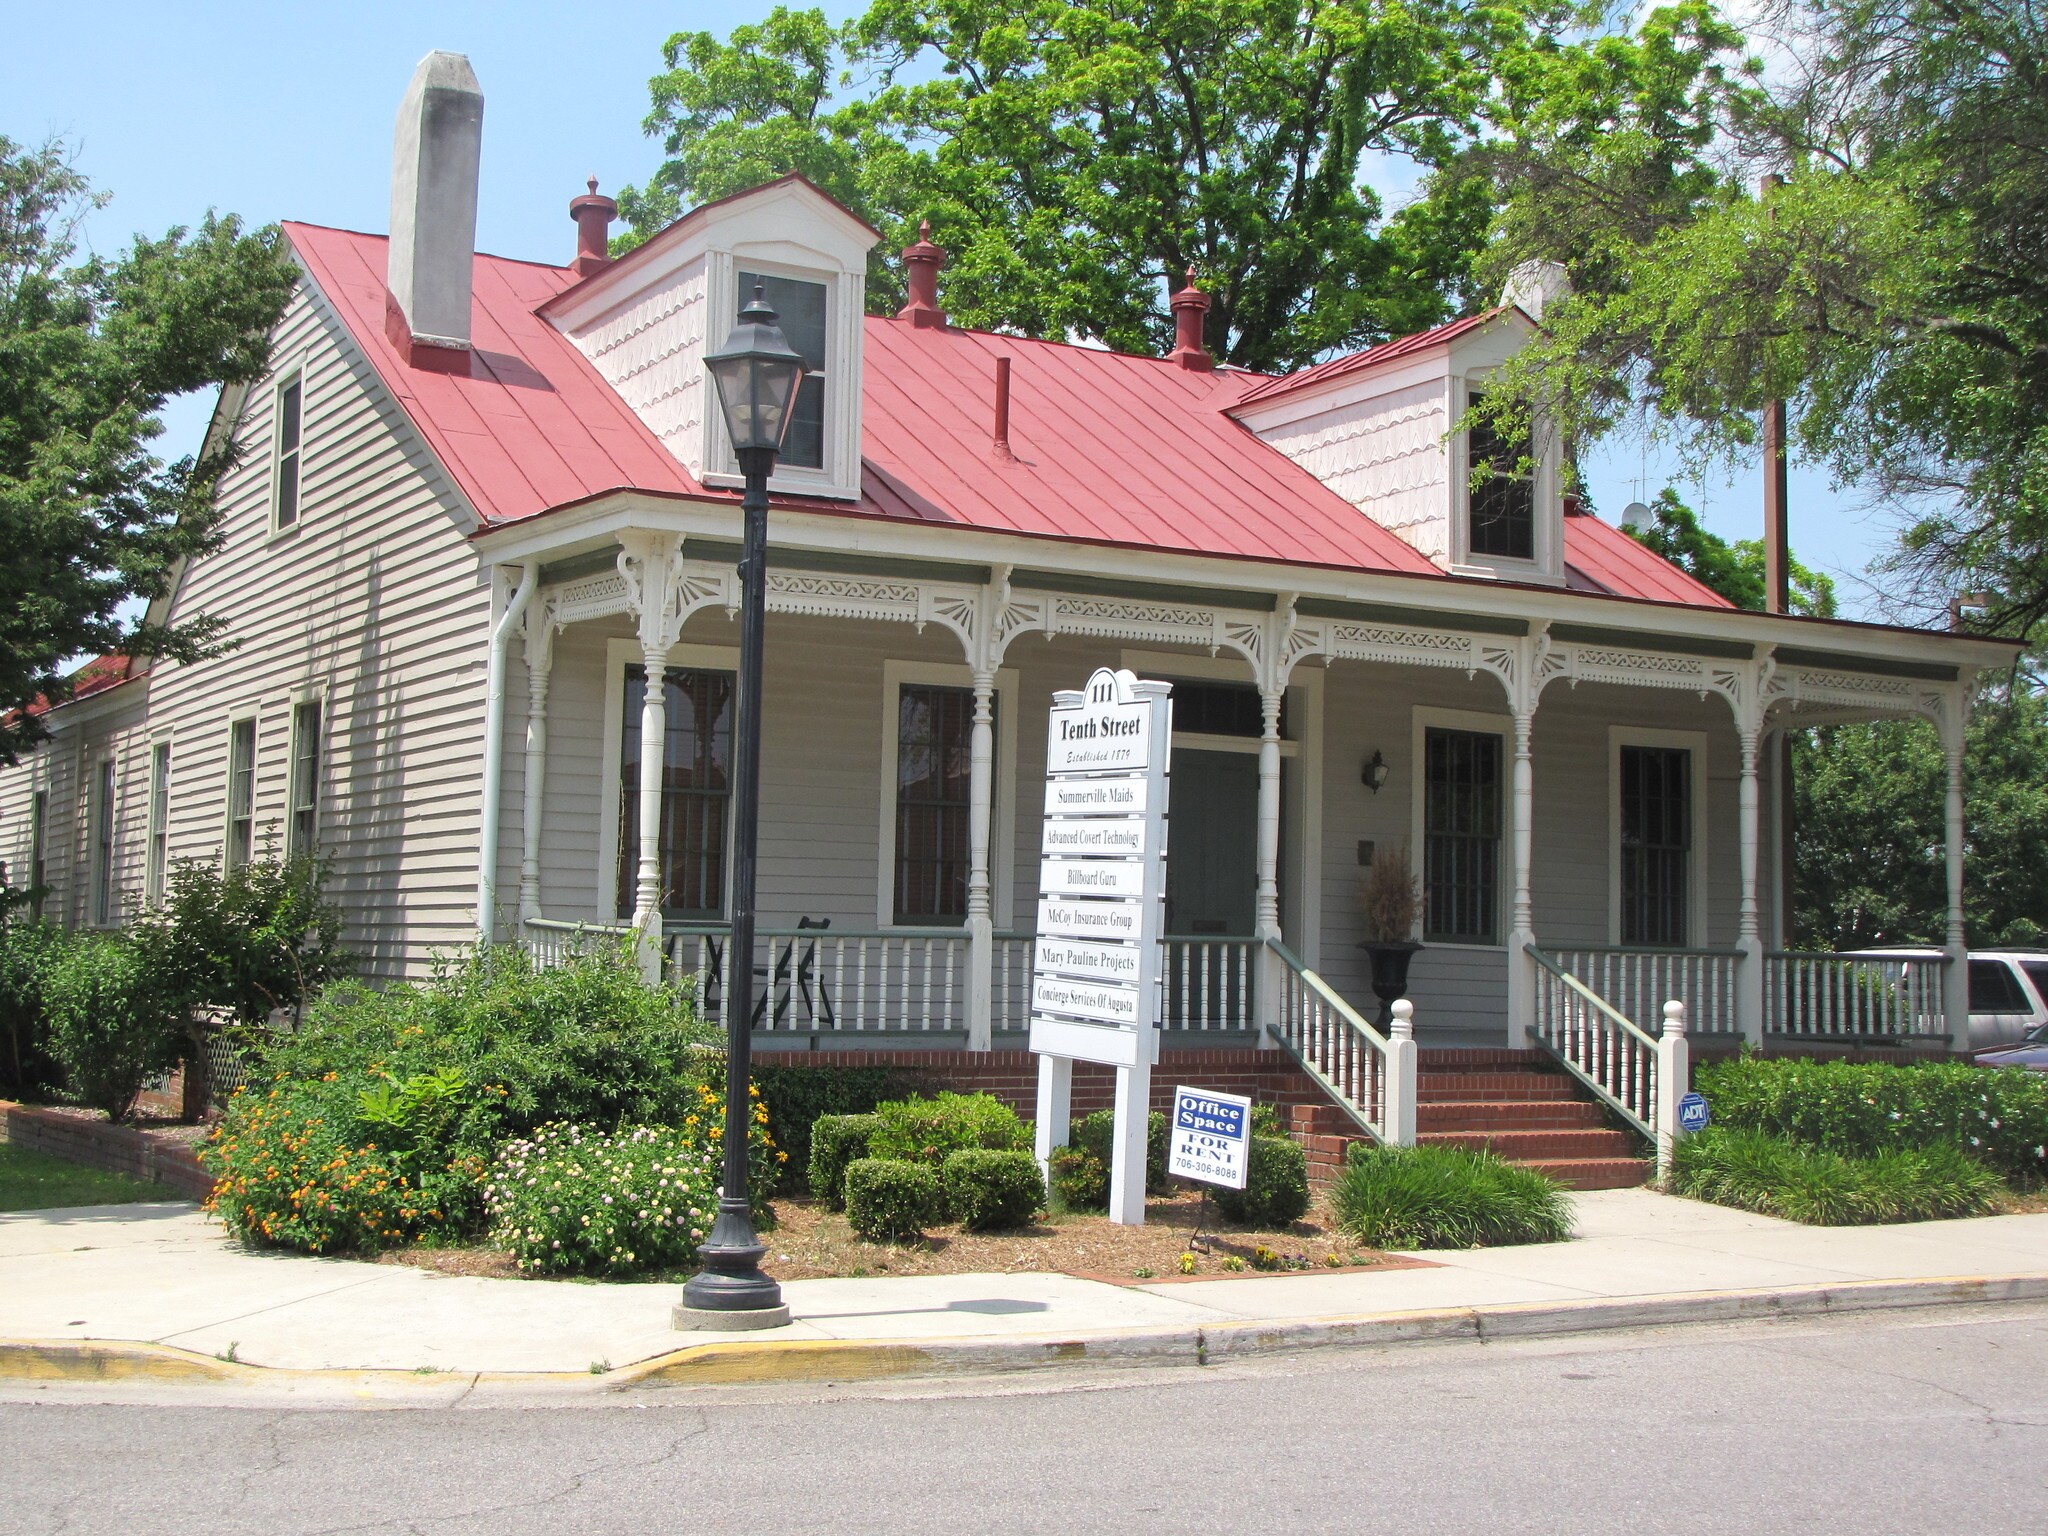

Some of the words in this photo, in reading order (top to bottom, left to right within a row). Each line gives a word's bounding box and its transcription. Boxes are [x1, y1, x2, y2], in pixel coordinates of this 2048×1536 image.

[1092, 683, 1112, 703] 111
[1061, 718, 1096, 740] Tenth
[1100, 716, 1140, 737] Street
[1067, 751, 1107, 763] Established
[1111, 750, 1130, 761] 1879
[1058, 789, 1107, 803] Summerville
[1109, 788, 1133, 802] Maids
[1047, 830, 1078, 844] Advanced
[1080, 830, 1101, 844] Covert
[1103, 830, 1139, 848] Technology
[1067, 869, 1098, 885] Billboard
[1100, 871, 1117, 885] Guru
[1048, 909, 1071, 926] McCoy
[1074, 910, 1108, 926] Insurance
[1110, 912, 1132, 930] Group
[1042, 948, 1064, 966] Mary
[1067, 950, 1098, 966] Pauline
[1101, 953, 1134, 972] Projects
[1038, 986, 1068, 1006] Concierge
[1070, 990, 1096, 1006] Services
[1098, 994, 1107, 1008] Of
[1108, 997, 1133, 1014] Augusta
[1181, 1098, 1239, 1119] Office
[1683, 1104, 1704, 1120] ADT
[1181, 1112, 1236, 1132] Space
[1189, 1134, 1228, 1150] FOR
[1181, 1144, 1235, 1163] RENT
[1176, 1157, 1236, 1179] 706-306-8088
